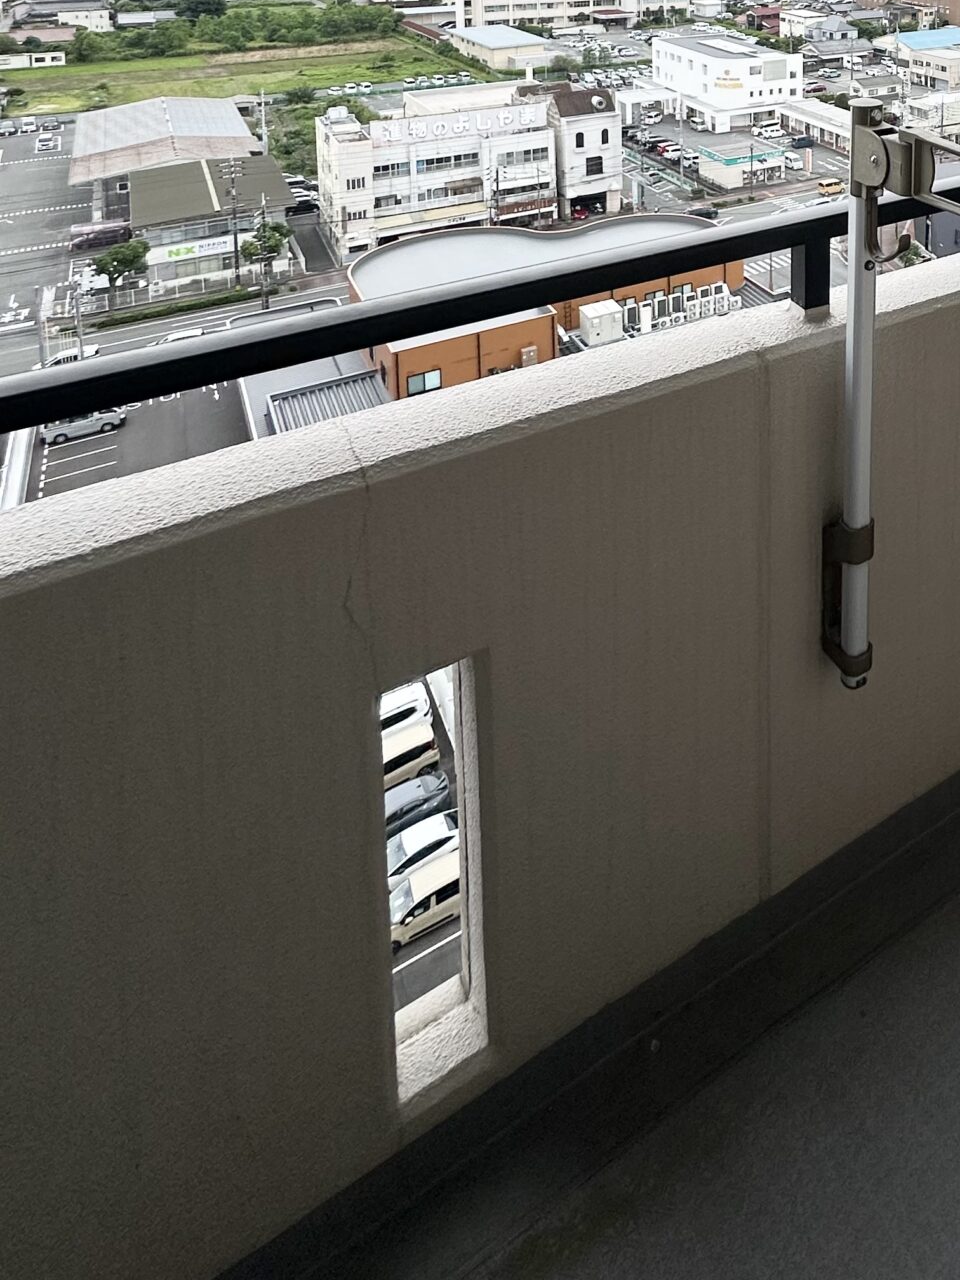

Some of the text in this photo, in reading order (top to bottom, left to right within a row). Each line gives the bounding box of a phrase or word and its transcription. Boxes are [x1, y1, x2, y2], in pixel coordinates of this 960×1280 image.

[382, 107, 537, 142] 進物のよしやま
